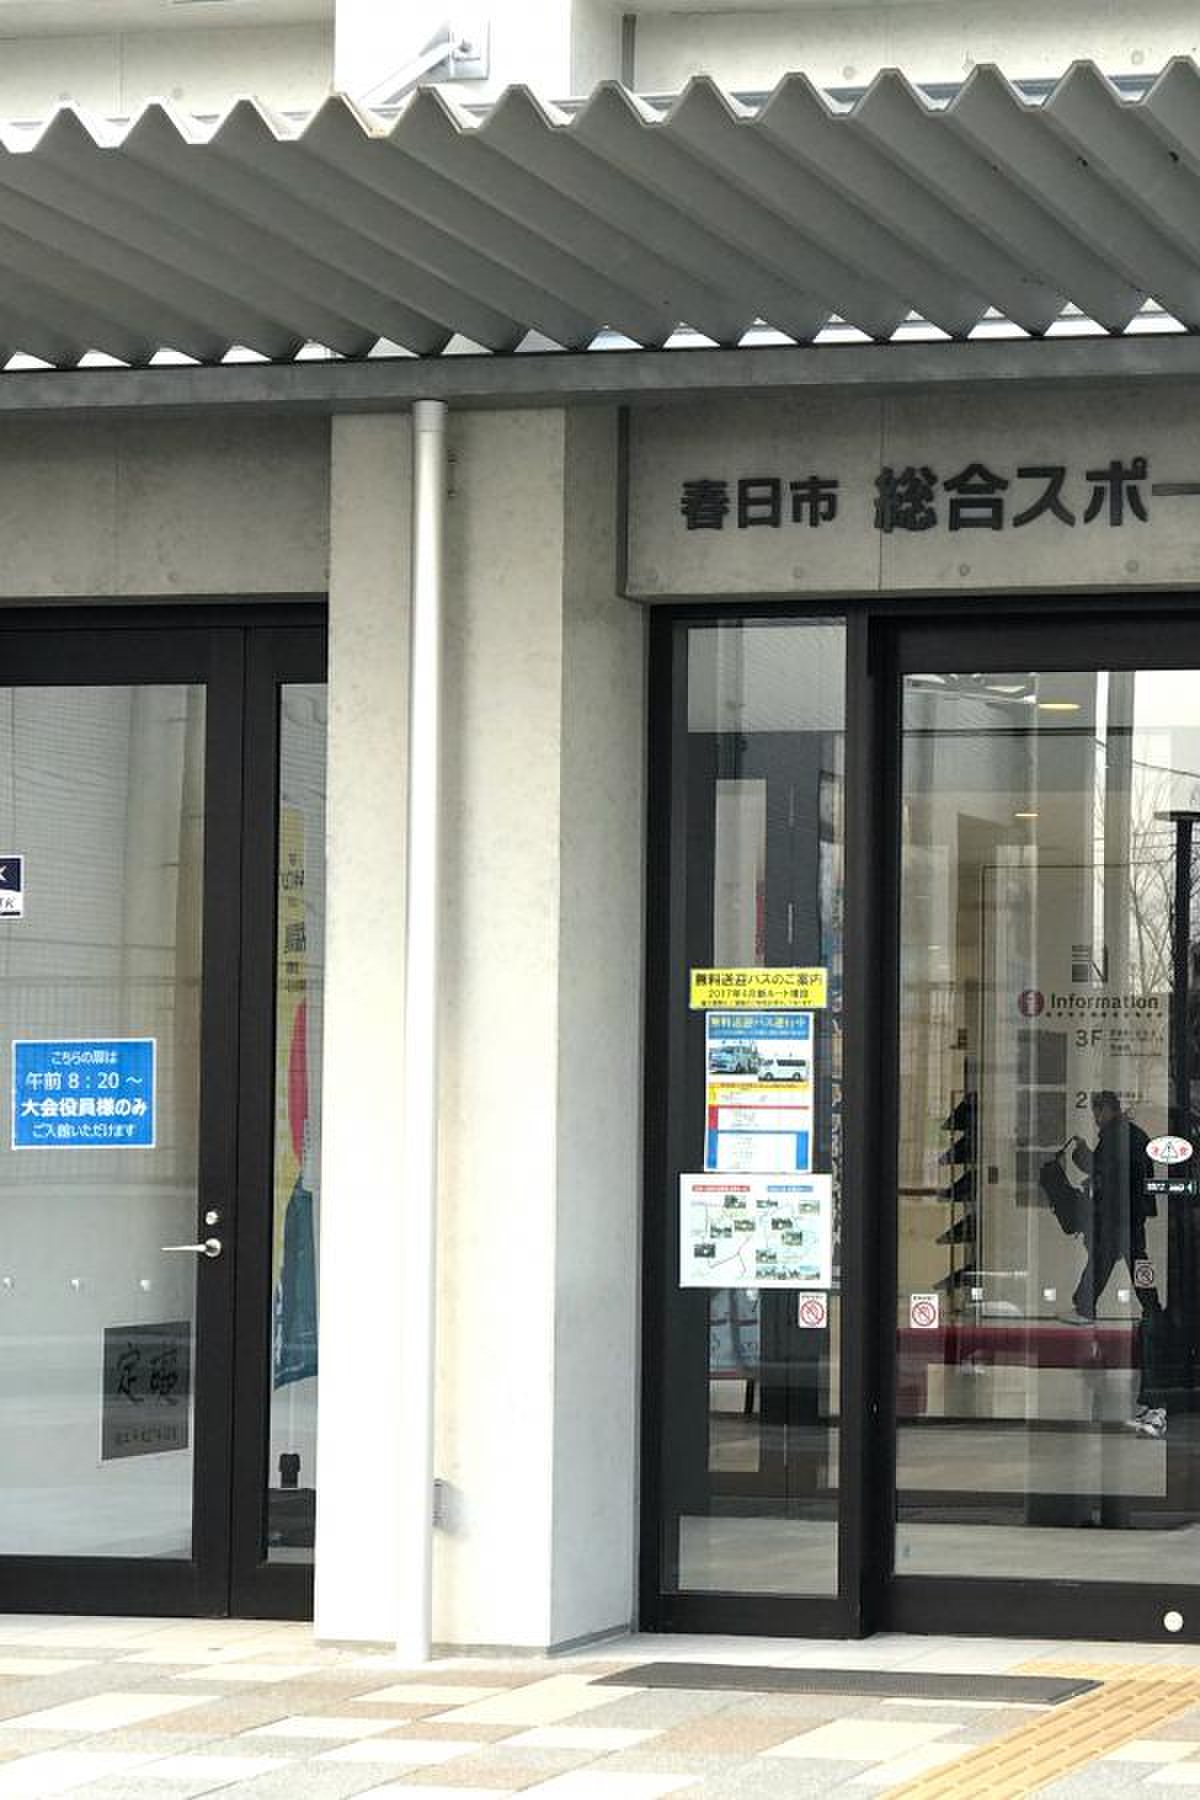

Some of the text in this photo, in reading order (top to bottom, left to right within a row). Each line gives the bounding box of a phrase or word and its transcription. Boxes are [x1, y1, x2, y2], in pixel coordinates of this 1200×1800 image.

[680, 475, 839, 531] 春日市
[1050, 993, 1160, 1009] Information
[1075, 1029, 1103, 1048] 3F
[21, 1097, 147, 1117] 大会役員様のみ
